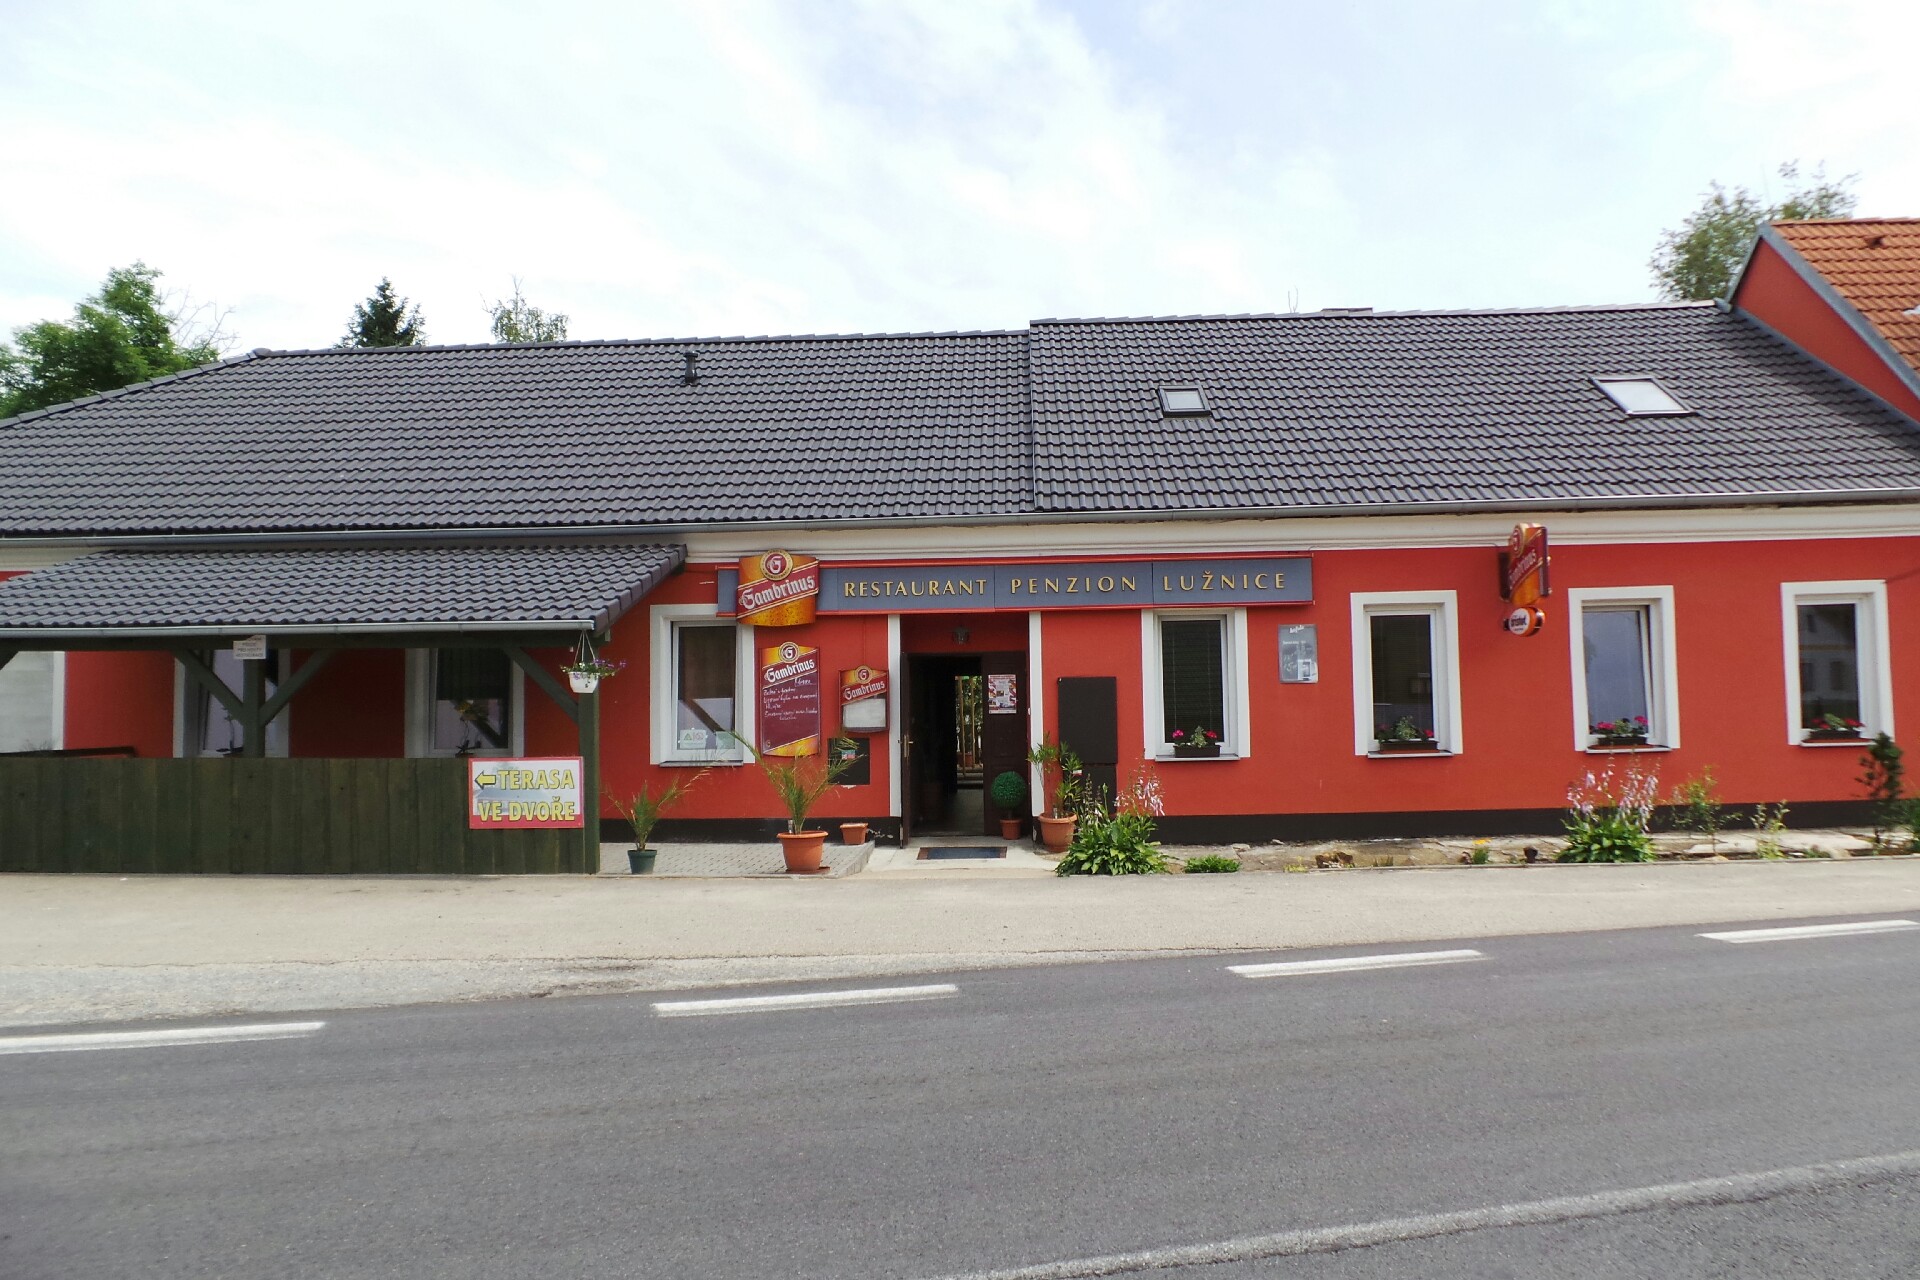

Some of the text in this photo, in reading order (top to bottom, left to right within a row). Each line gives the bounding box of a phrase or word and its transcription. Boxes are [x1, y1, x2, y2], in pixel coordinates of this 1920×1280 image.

[739, 575, 816, 610] Gambrinus
[844, 570, 1285, 597] RESTAURANT PENZION LUŽNICE
[764, 658, 815, 683] Gambrinus
[843, 680, 886, 701] Gambrinus
[497, 769, 575, 790] TERASA
[478, 796, 575, 822] VE DVOŘE
